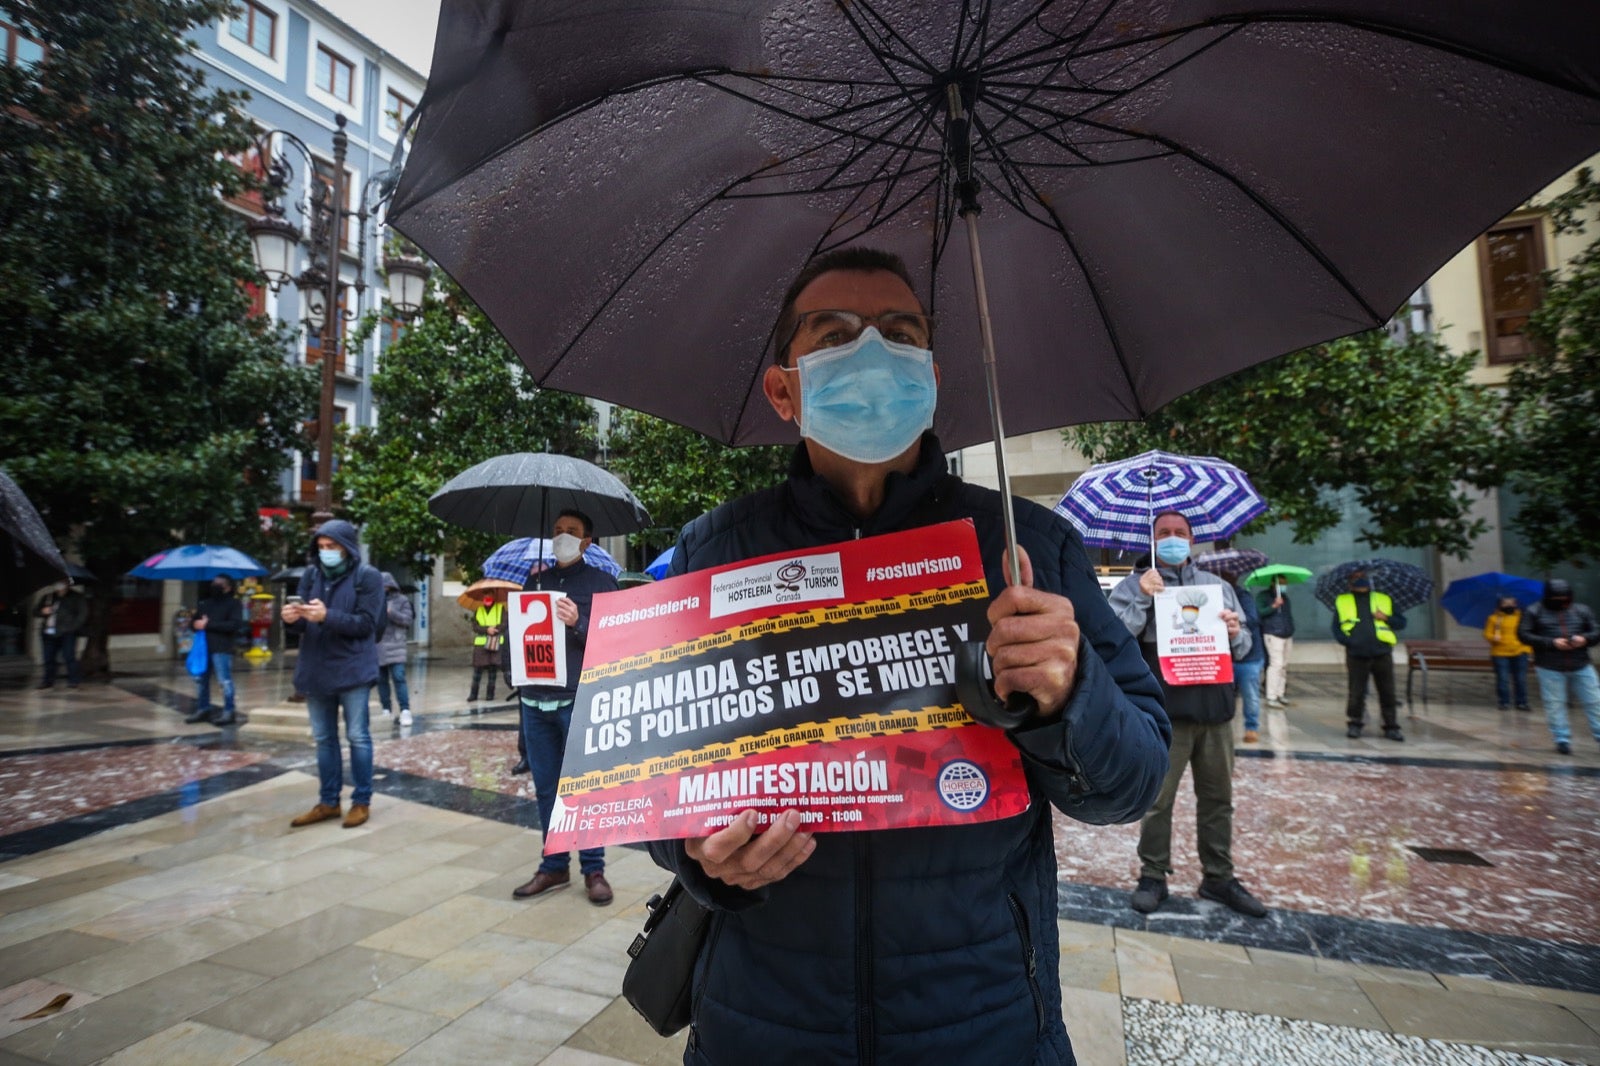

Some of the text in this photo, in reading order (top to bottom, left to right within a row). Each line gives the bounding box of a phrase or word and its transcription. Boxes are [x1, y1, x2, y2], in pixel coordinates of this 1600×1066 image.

[811, 565, 839, 576] Empresas
[866, 555, 962, 582] #sosturismo
[713, 572, 772, 593] Federación Provincial
[728, 584, 772, 602] HOSTELERIA
[804, 576, 839, 589] TURISMO
[776, 591, 801, 602] Granada
[599, 596, 700, 629] #soshosteleria
[582, 585, 986, 680] ATENCIÓN GRANADA ATENCIÓN GRANADA ATENCIÓN GRANADA ATENCIÓN GRANADA ATENCIÓN GRANADA
[526, 644, 553, 663] NOS
[590, 658, 740, 724] GRANADA
[746, 654, 780, 686] SE
[786, 626, 951, 677] EMPOBRECE
[584, 718, 632, 755] LOS
[640, 685, 775, 743] POLITICOS
[781, 676, 820, 709] NO
[836, 667, 872, 698] SE
[560, 708, 968, 793] ATENCIÓN GRANADA ATENCIÓN GRANADA ATENCIÓN GRANADA ATENCIÓN GRANADA ATENCIÓN
[679, 751, 888, 804] MANIFESTACIÓN
[943, 779, 983, 792] HORECA
[582, 794, 653, 816] HOSTELERÍA
[664, 808, 684, 818] Desde
[685, 806, 692, 814] la
[722, 800, 732, 809] de
[733, 796, 778, 808] constitución,
[780, 797, 797, 807] gran
[798, 795, 809, 805] vía
[810, 795, 830, 805] hasta
[831, 794, 856, 805] palacio
[857, 794, 865, 803] de
[867, 794, 904, 804] congresos
[832, 809, 862, 822] 11:00h
[579, 811, 645, 830] DE ESPAÑA
